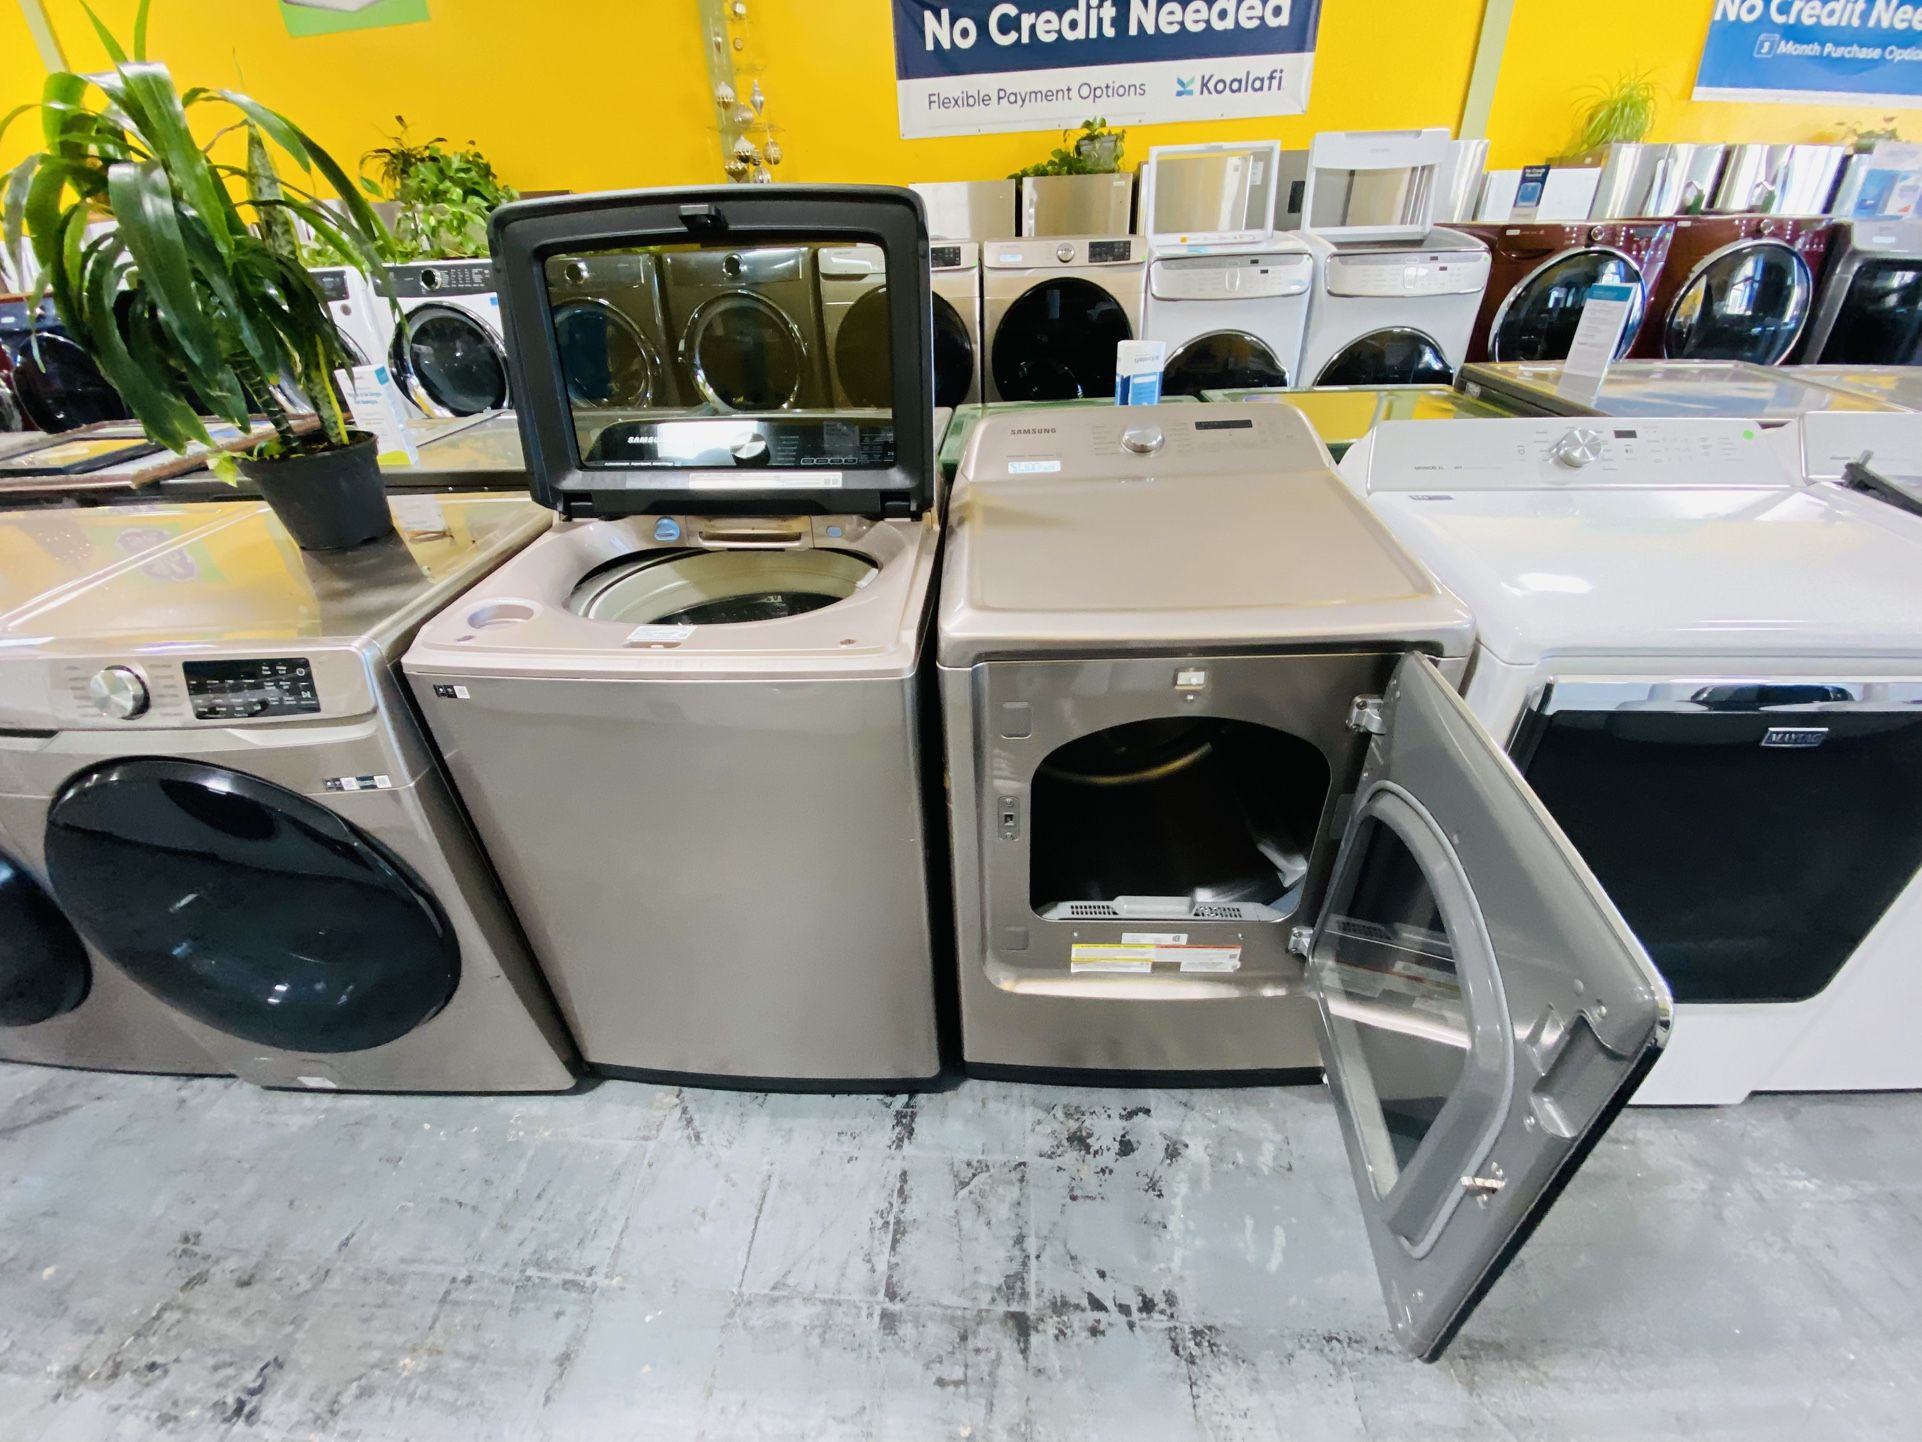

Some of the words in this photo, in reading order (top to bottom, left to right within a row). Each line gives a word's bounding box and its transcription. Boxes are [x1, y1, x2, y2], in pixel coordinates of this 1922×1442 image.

[923, 8, 977, 51] No
[988, 0, 1116, 46] Credit
[1128, 0, 1292, 36] Needed
[1713, 0, 1764, 23] No
[1769, 0, 1866, 28] Credit
[1867, 0, 1922, 30] Nee
[1776, 40, 1821, 57] Month
[1823, 43, 1882, 59] Purchase
[1884, 45, 1922, 63] Optio
[927, 90, 992, 111] Flexible
[997, 86, 1072, 108] Payment
[1077, 81, 1147, 100] Options
[1200, 69, 1284, 96] Koalafi
[627, 436, 665, 444] SAMSU
[1010, 427, 1057, 435] SAMSUNG
